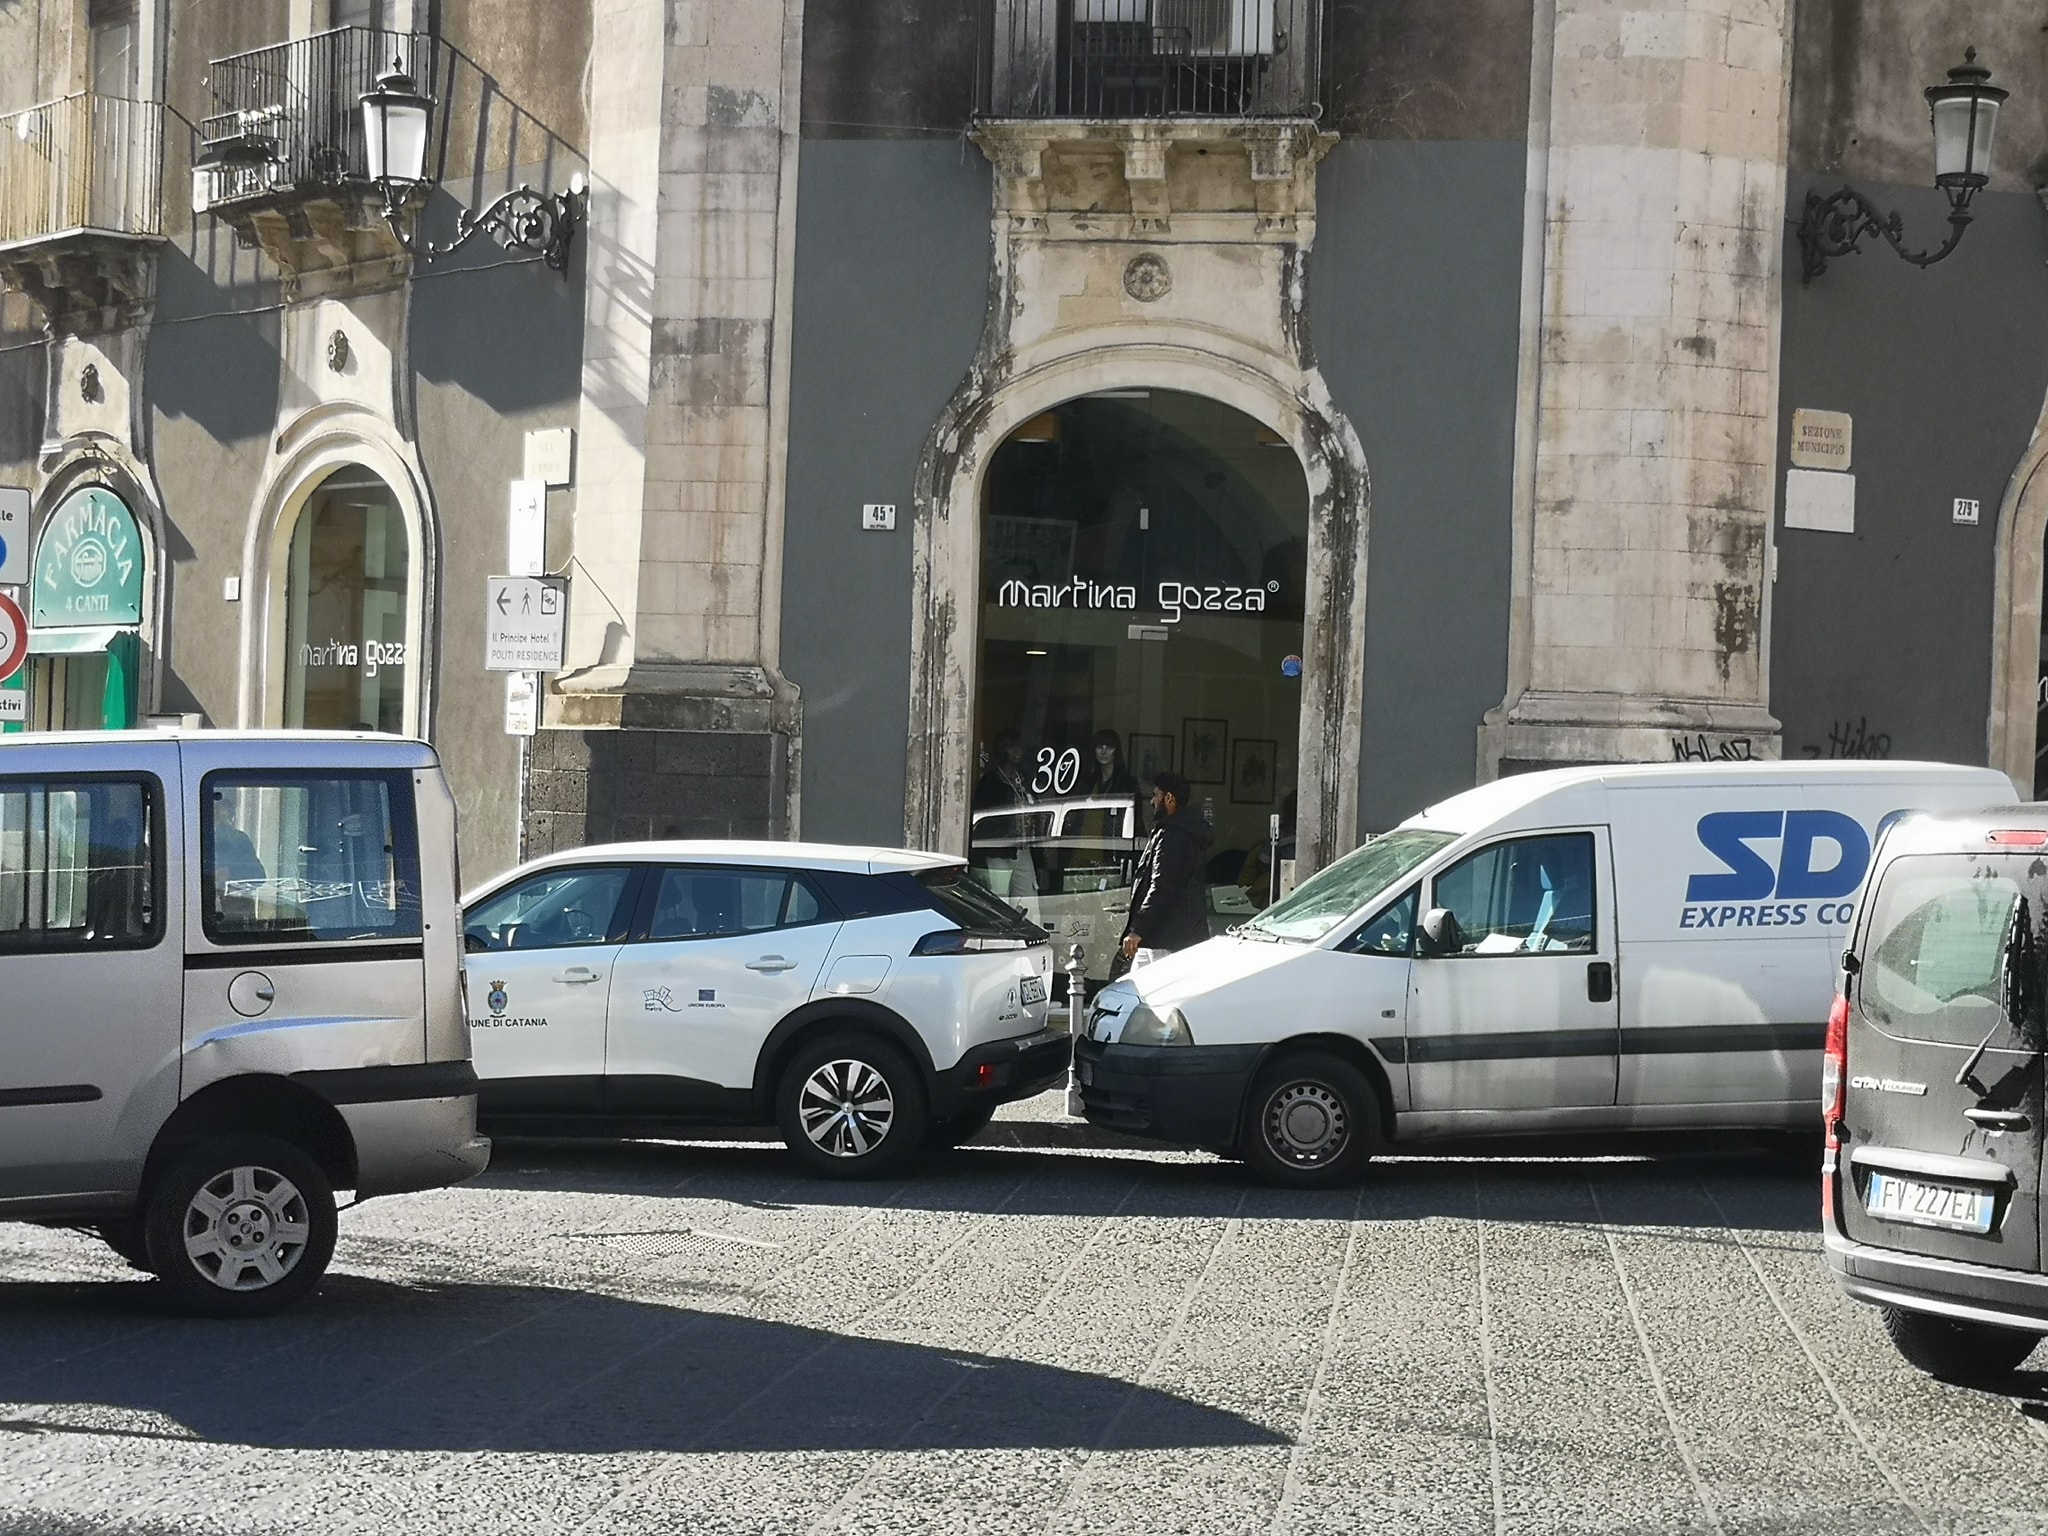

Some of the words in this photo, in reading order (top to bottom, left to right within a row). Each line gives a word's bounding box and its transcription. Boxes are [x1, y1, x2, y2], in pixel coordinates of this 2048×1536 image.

[1802, 425, 1842, 439] SEZIONE
[1797, 441, 1845, 456] MUNICIPIO
[872, 506, 886, 521] 45
[1957, 500, 1972, 516] 279
[44, 502, 133, 590] FARMACIA
[65, 596, 73, 612] 4
[76, 594, 109, 612] CANTI
[500, 632, 528, 645] Principe
[530, 633, 550, 644] Hotel
[491, 649, 514, 661] POLITI
[516, 650, 559, 662] RESIDENCE
[1685, 810, 1900, 902] SD
[1679, 904, 1808, 929] EXPRESS
[493, 1019, 503, 1027] DI
[505, 1018, 548, 1027] CATANIA
[1882, 1181, 1909, 1210] FV
